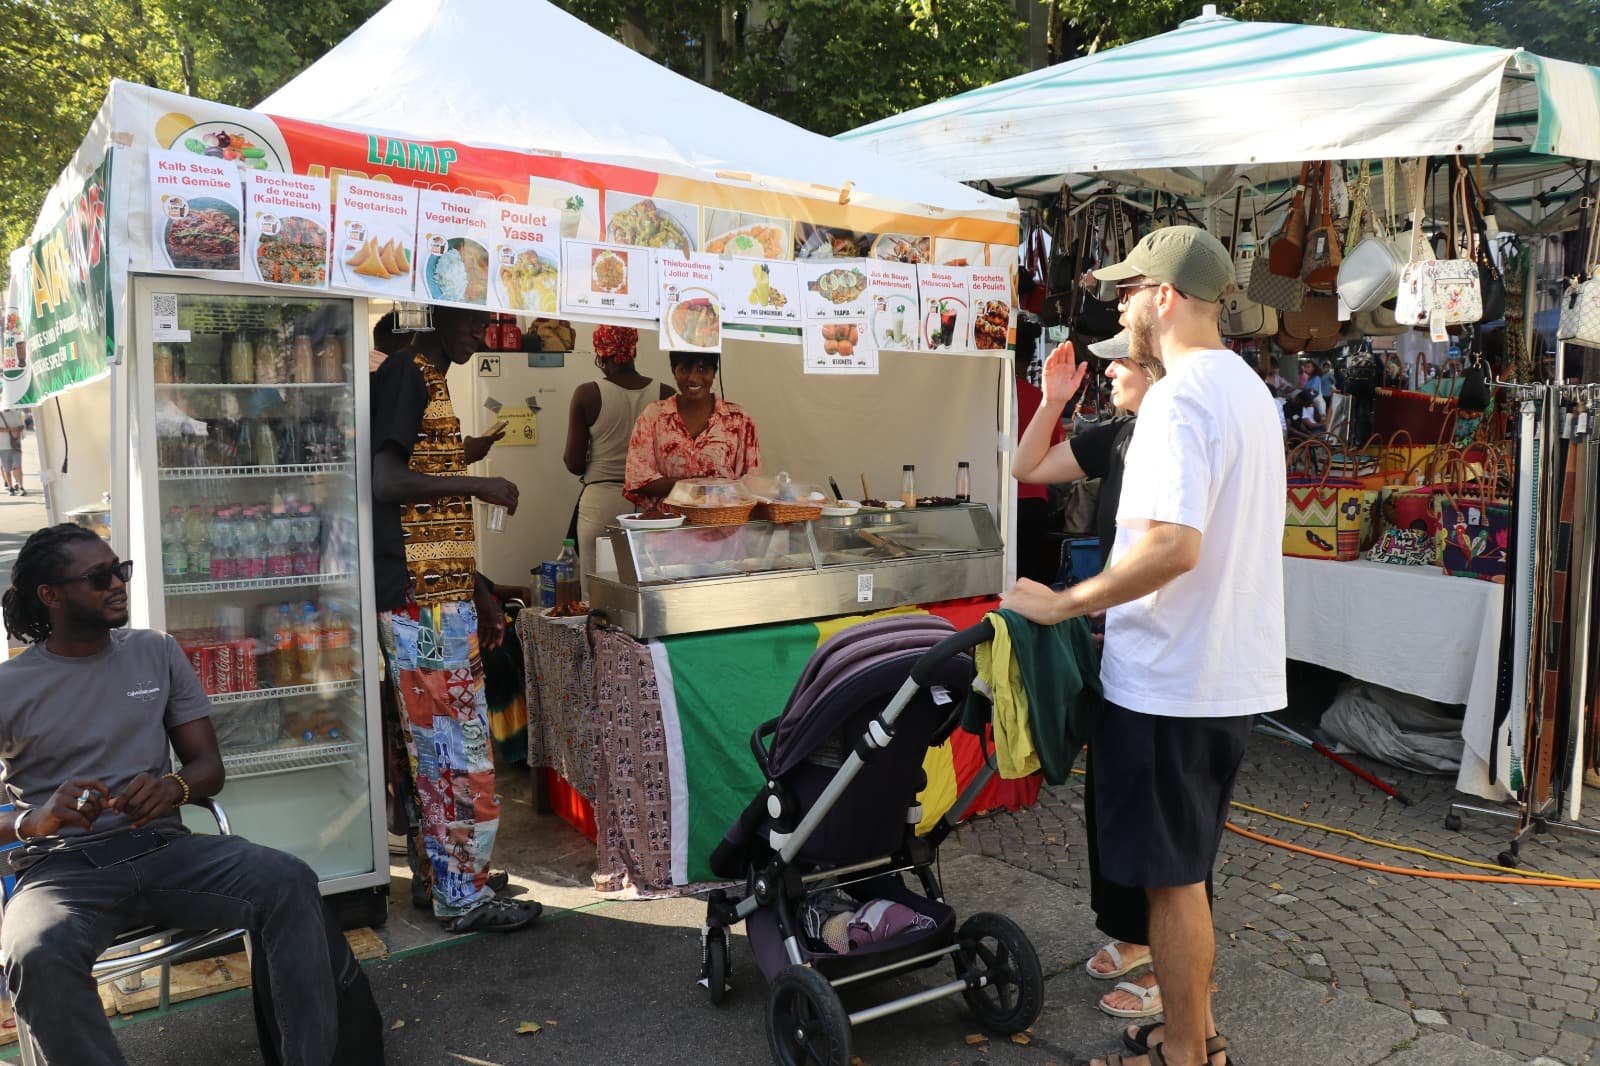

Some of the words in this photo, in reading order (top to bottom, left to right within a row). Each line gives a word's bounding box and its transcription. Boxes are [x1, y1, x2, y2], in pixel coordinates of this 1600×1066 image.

[367, 135, 458, 175] LAMP
[158, 161, 186, 172] Kalb
[190, 163, 224, 176] Steak
[157, 175, 178, 185] mit
[181, 176, 231, 189] Gemüse
[255, 175, 315, 191] Brochettes
[266, 186, 279, 196] de
[283, 190, 309, 200] veau
[349, 185, 404, 203] Samossas
[253, 194, 321, 212] (Kalbfleisch)
[344, 198, 408, 216] Vegetarisch
[441, 201, 470, 214] Thiou
[425, 212, 487, 229] Vegetarisch
[501, 209, 548, 227] Poulet
[503, 226, 544, 243] Yassa
[662, 259, 711, 270] Thieboudiene
[870, 271, 881, 279] Jus
[973, 274, 1005, 283] Brochette
[973, 282, 982, 290] de
